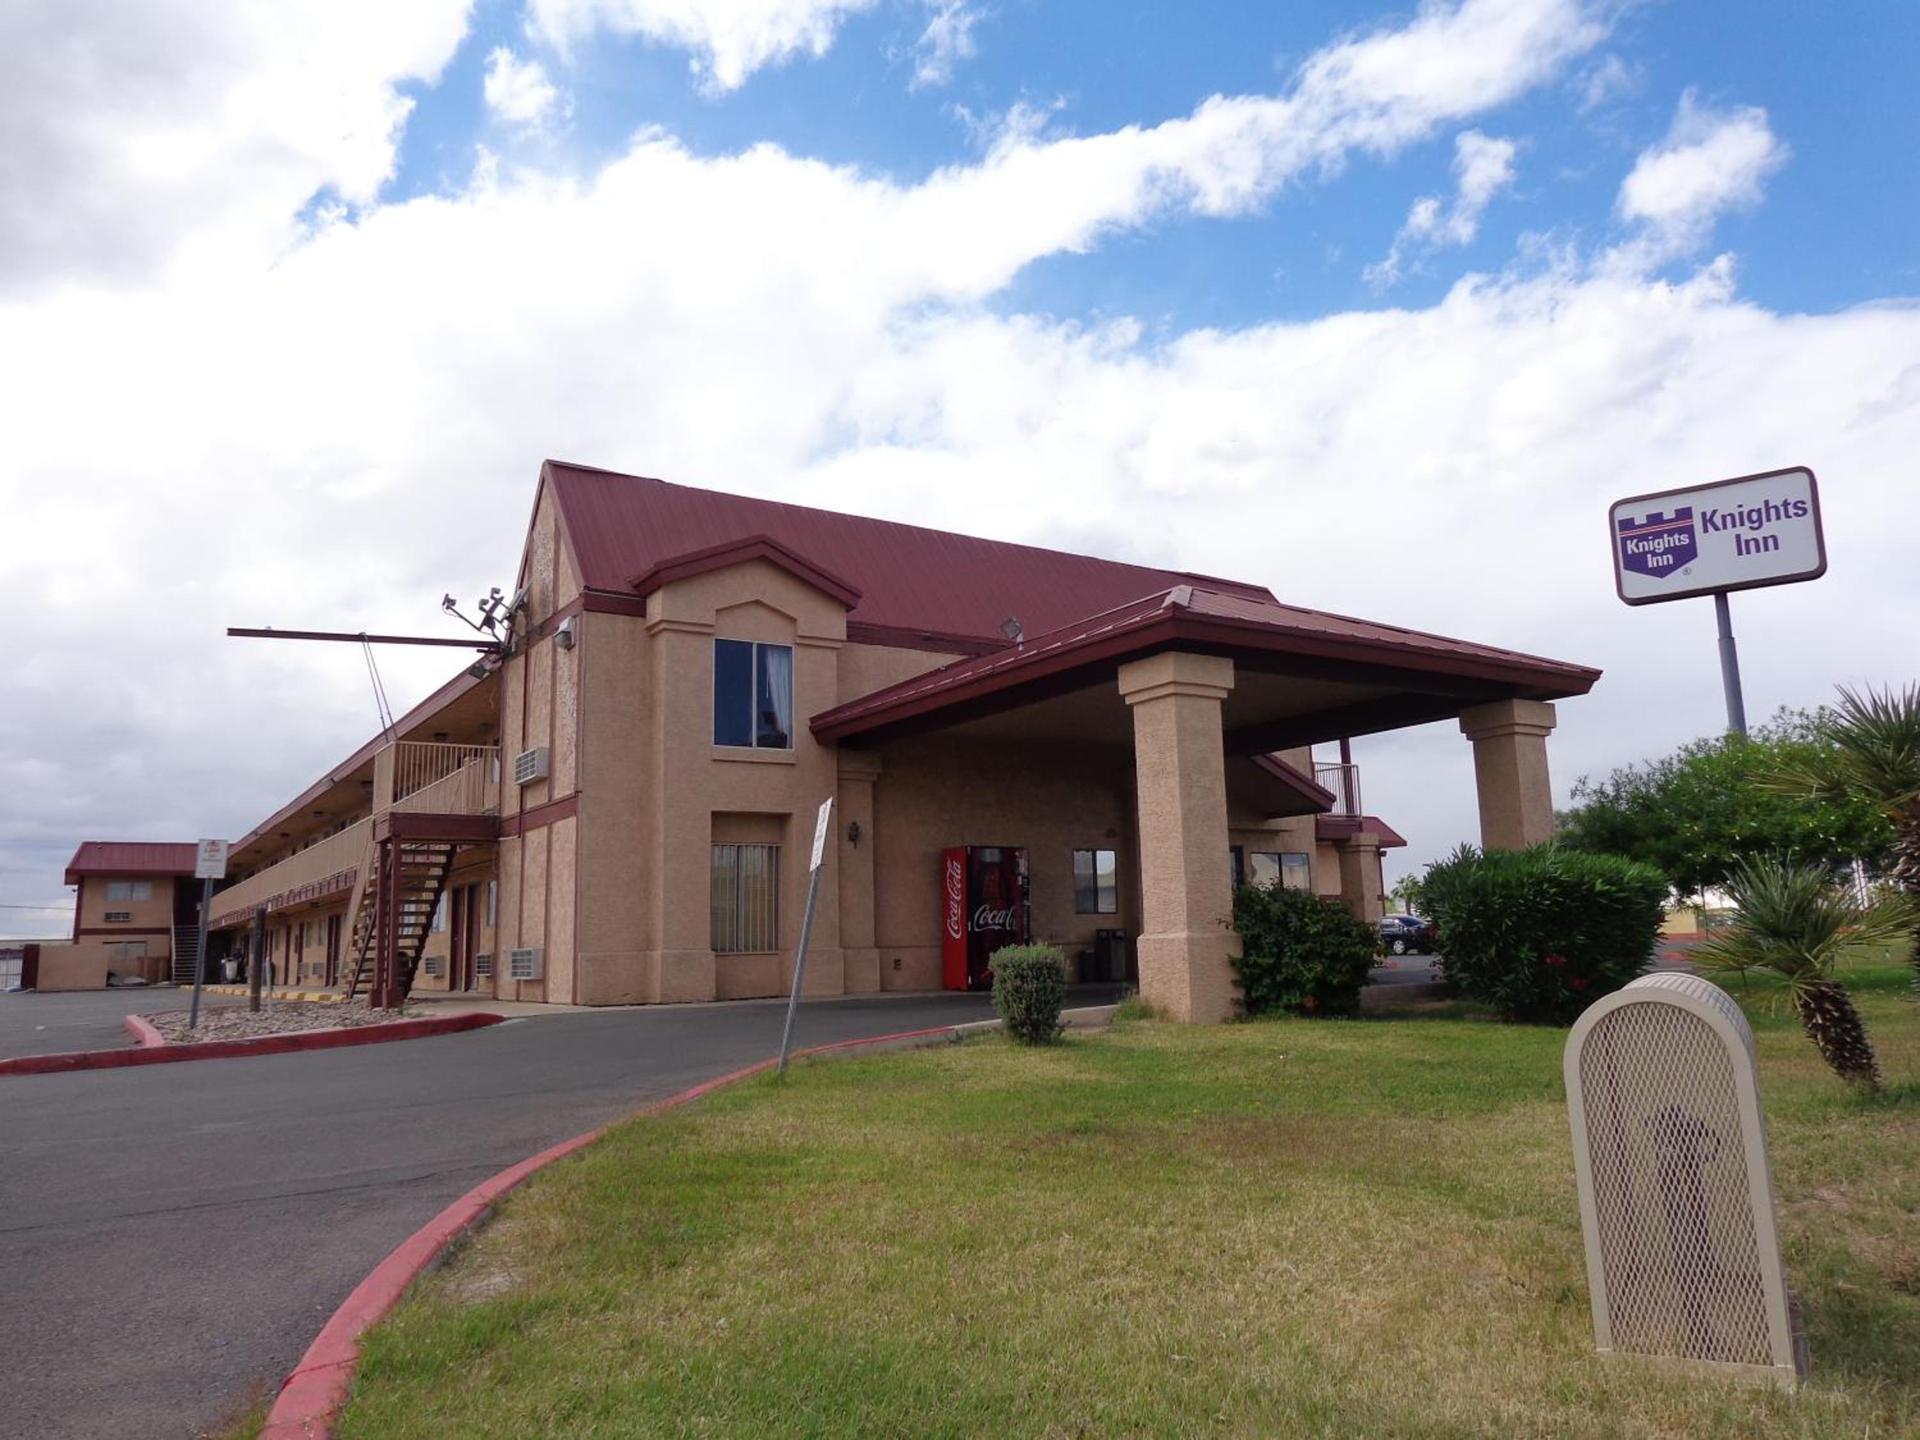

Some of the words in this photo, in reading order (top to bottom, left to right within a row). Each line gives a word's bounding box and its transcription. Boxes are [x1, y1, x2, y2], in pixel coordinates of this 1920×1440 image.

[1701, 498, 1808, 533] Knights
[1626, 533, 1690, 555] Knights
[1736, 534, 1779, 556] Inn
[1647, 553, 1674, 568] Inn
